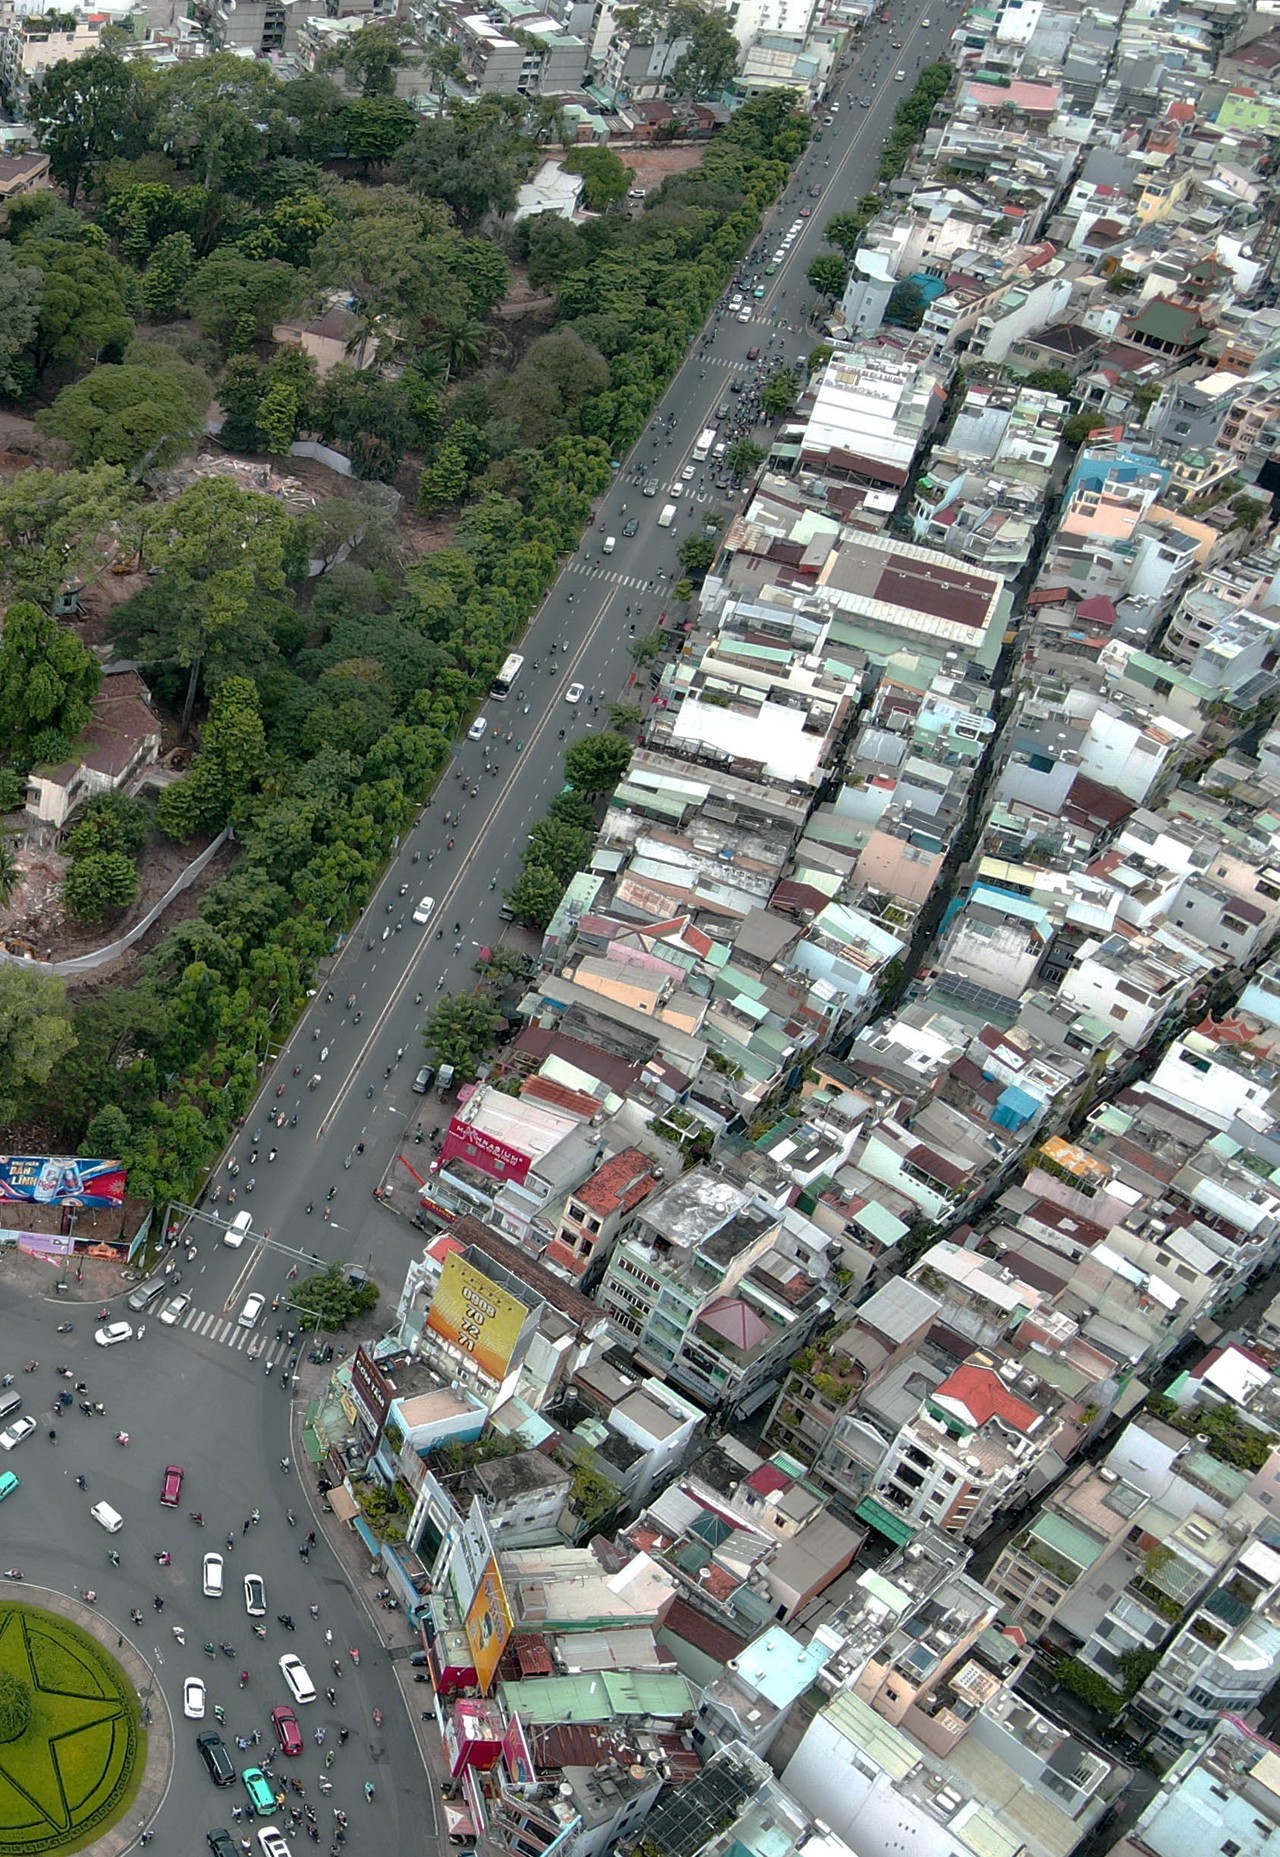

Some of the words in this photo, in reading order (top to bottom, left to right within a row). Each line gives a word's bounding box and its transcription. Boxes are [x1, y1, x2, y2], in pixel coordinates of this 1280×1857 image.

[462, 1286, 496, 1319] 0908
[466, 1304, 485, 1326] 70
[461, 1317, 481, 1339] 72
[457, 1331, 475, 1353] 71
